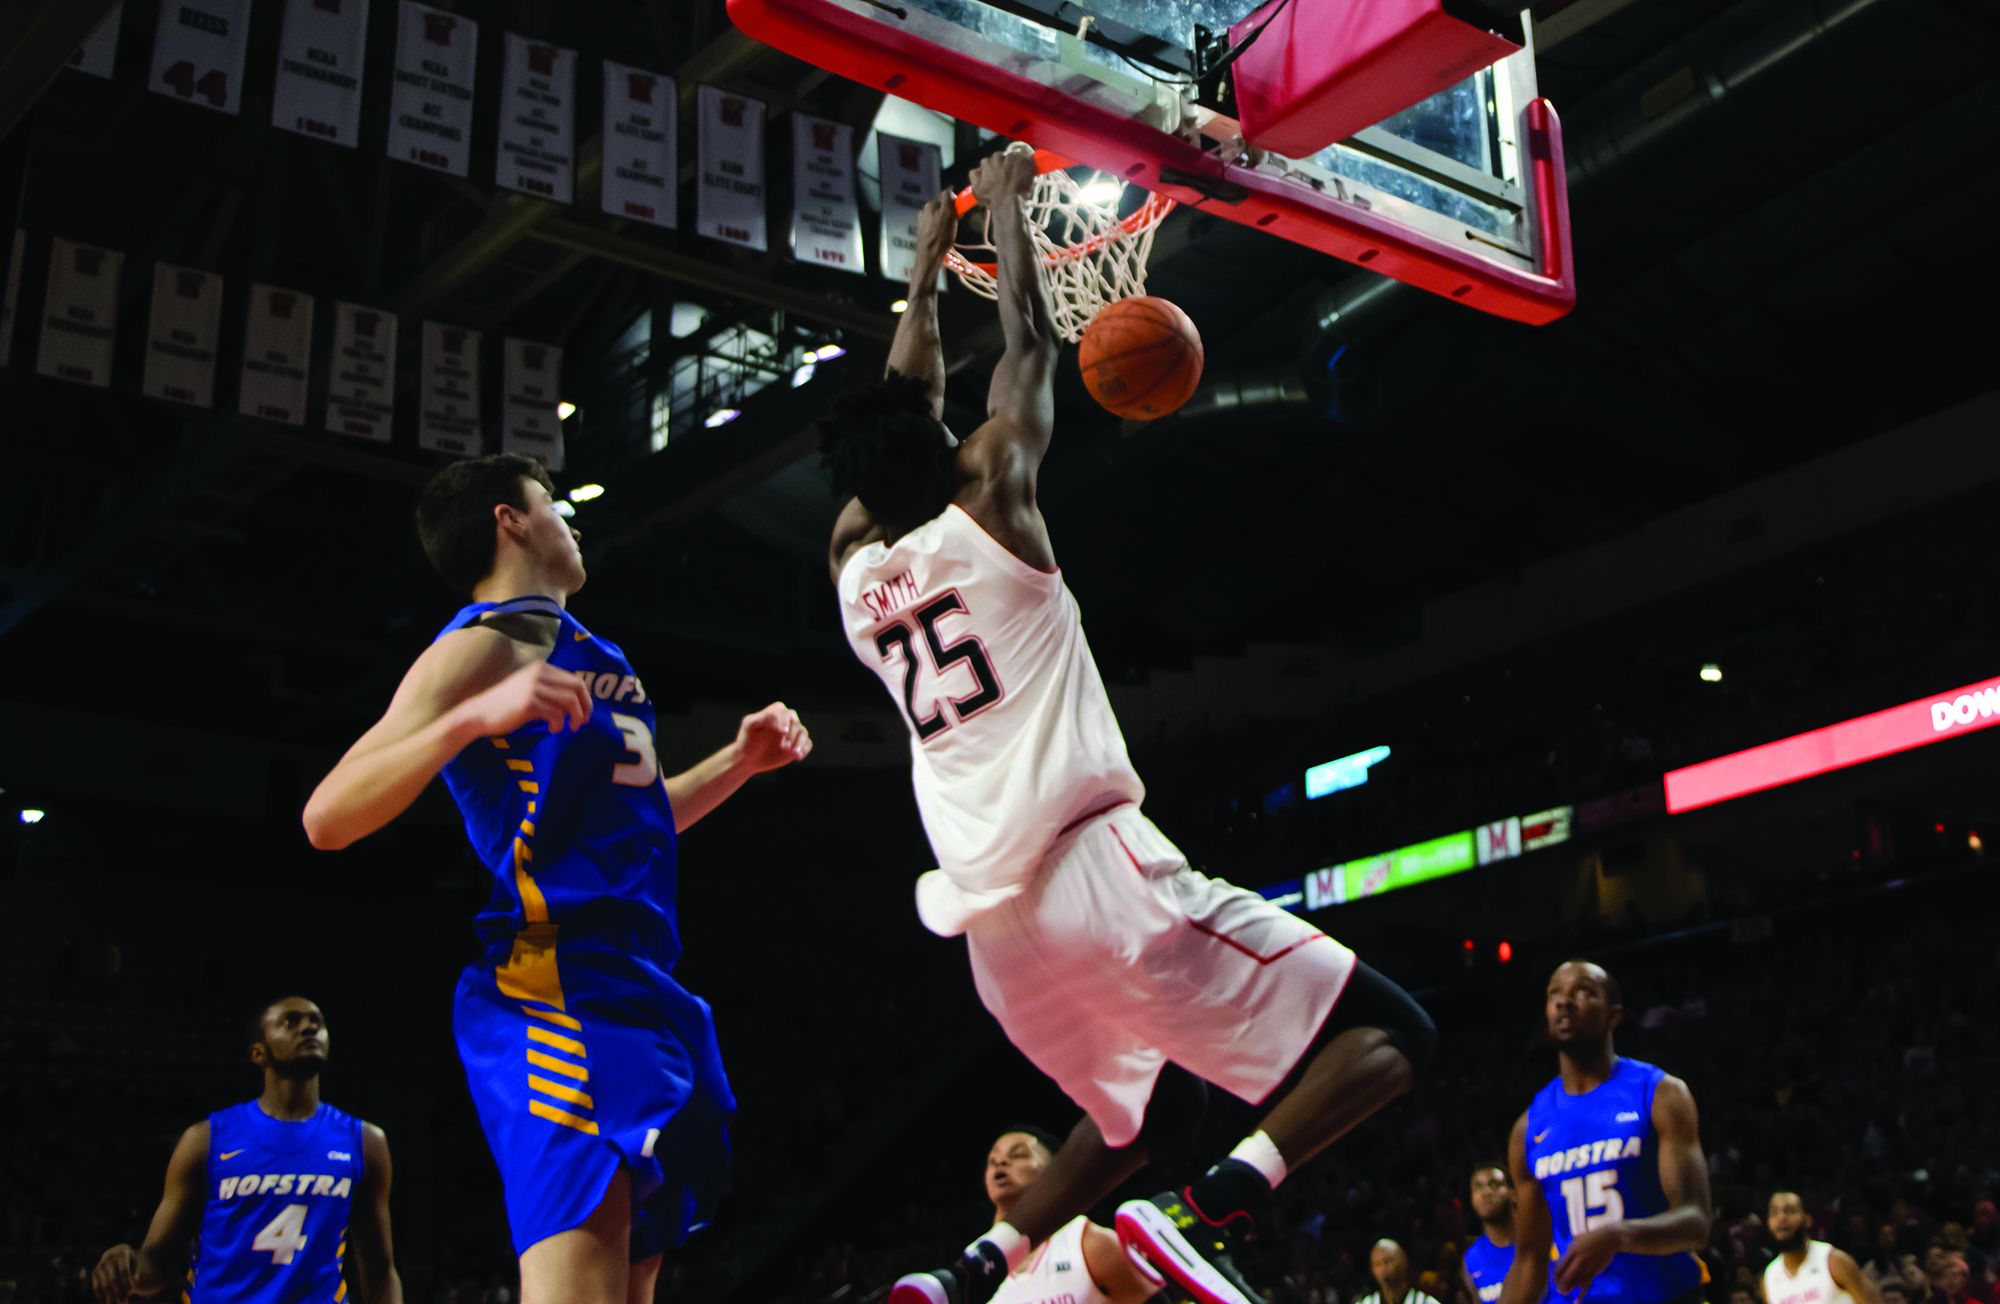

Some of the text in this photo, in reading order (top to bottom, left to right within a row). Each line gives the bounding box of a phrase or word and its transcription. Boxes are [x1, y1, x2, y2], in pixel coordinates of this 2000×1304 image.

[163, 60, 227, 106] 44
[862, 569, 920, 622] SMITH
[575, 670, 652, 705] HOFS
[873, 587, 1005, 745] 25
[1534, 1136, 1642, 1181] HOFSTRA
[219, 1173, 352, 1201] HOFSTRA
[1560, 1168, 1625, 1238] 15
[251, 1203, 308, 1266] 4
